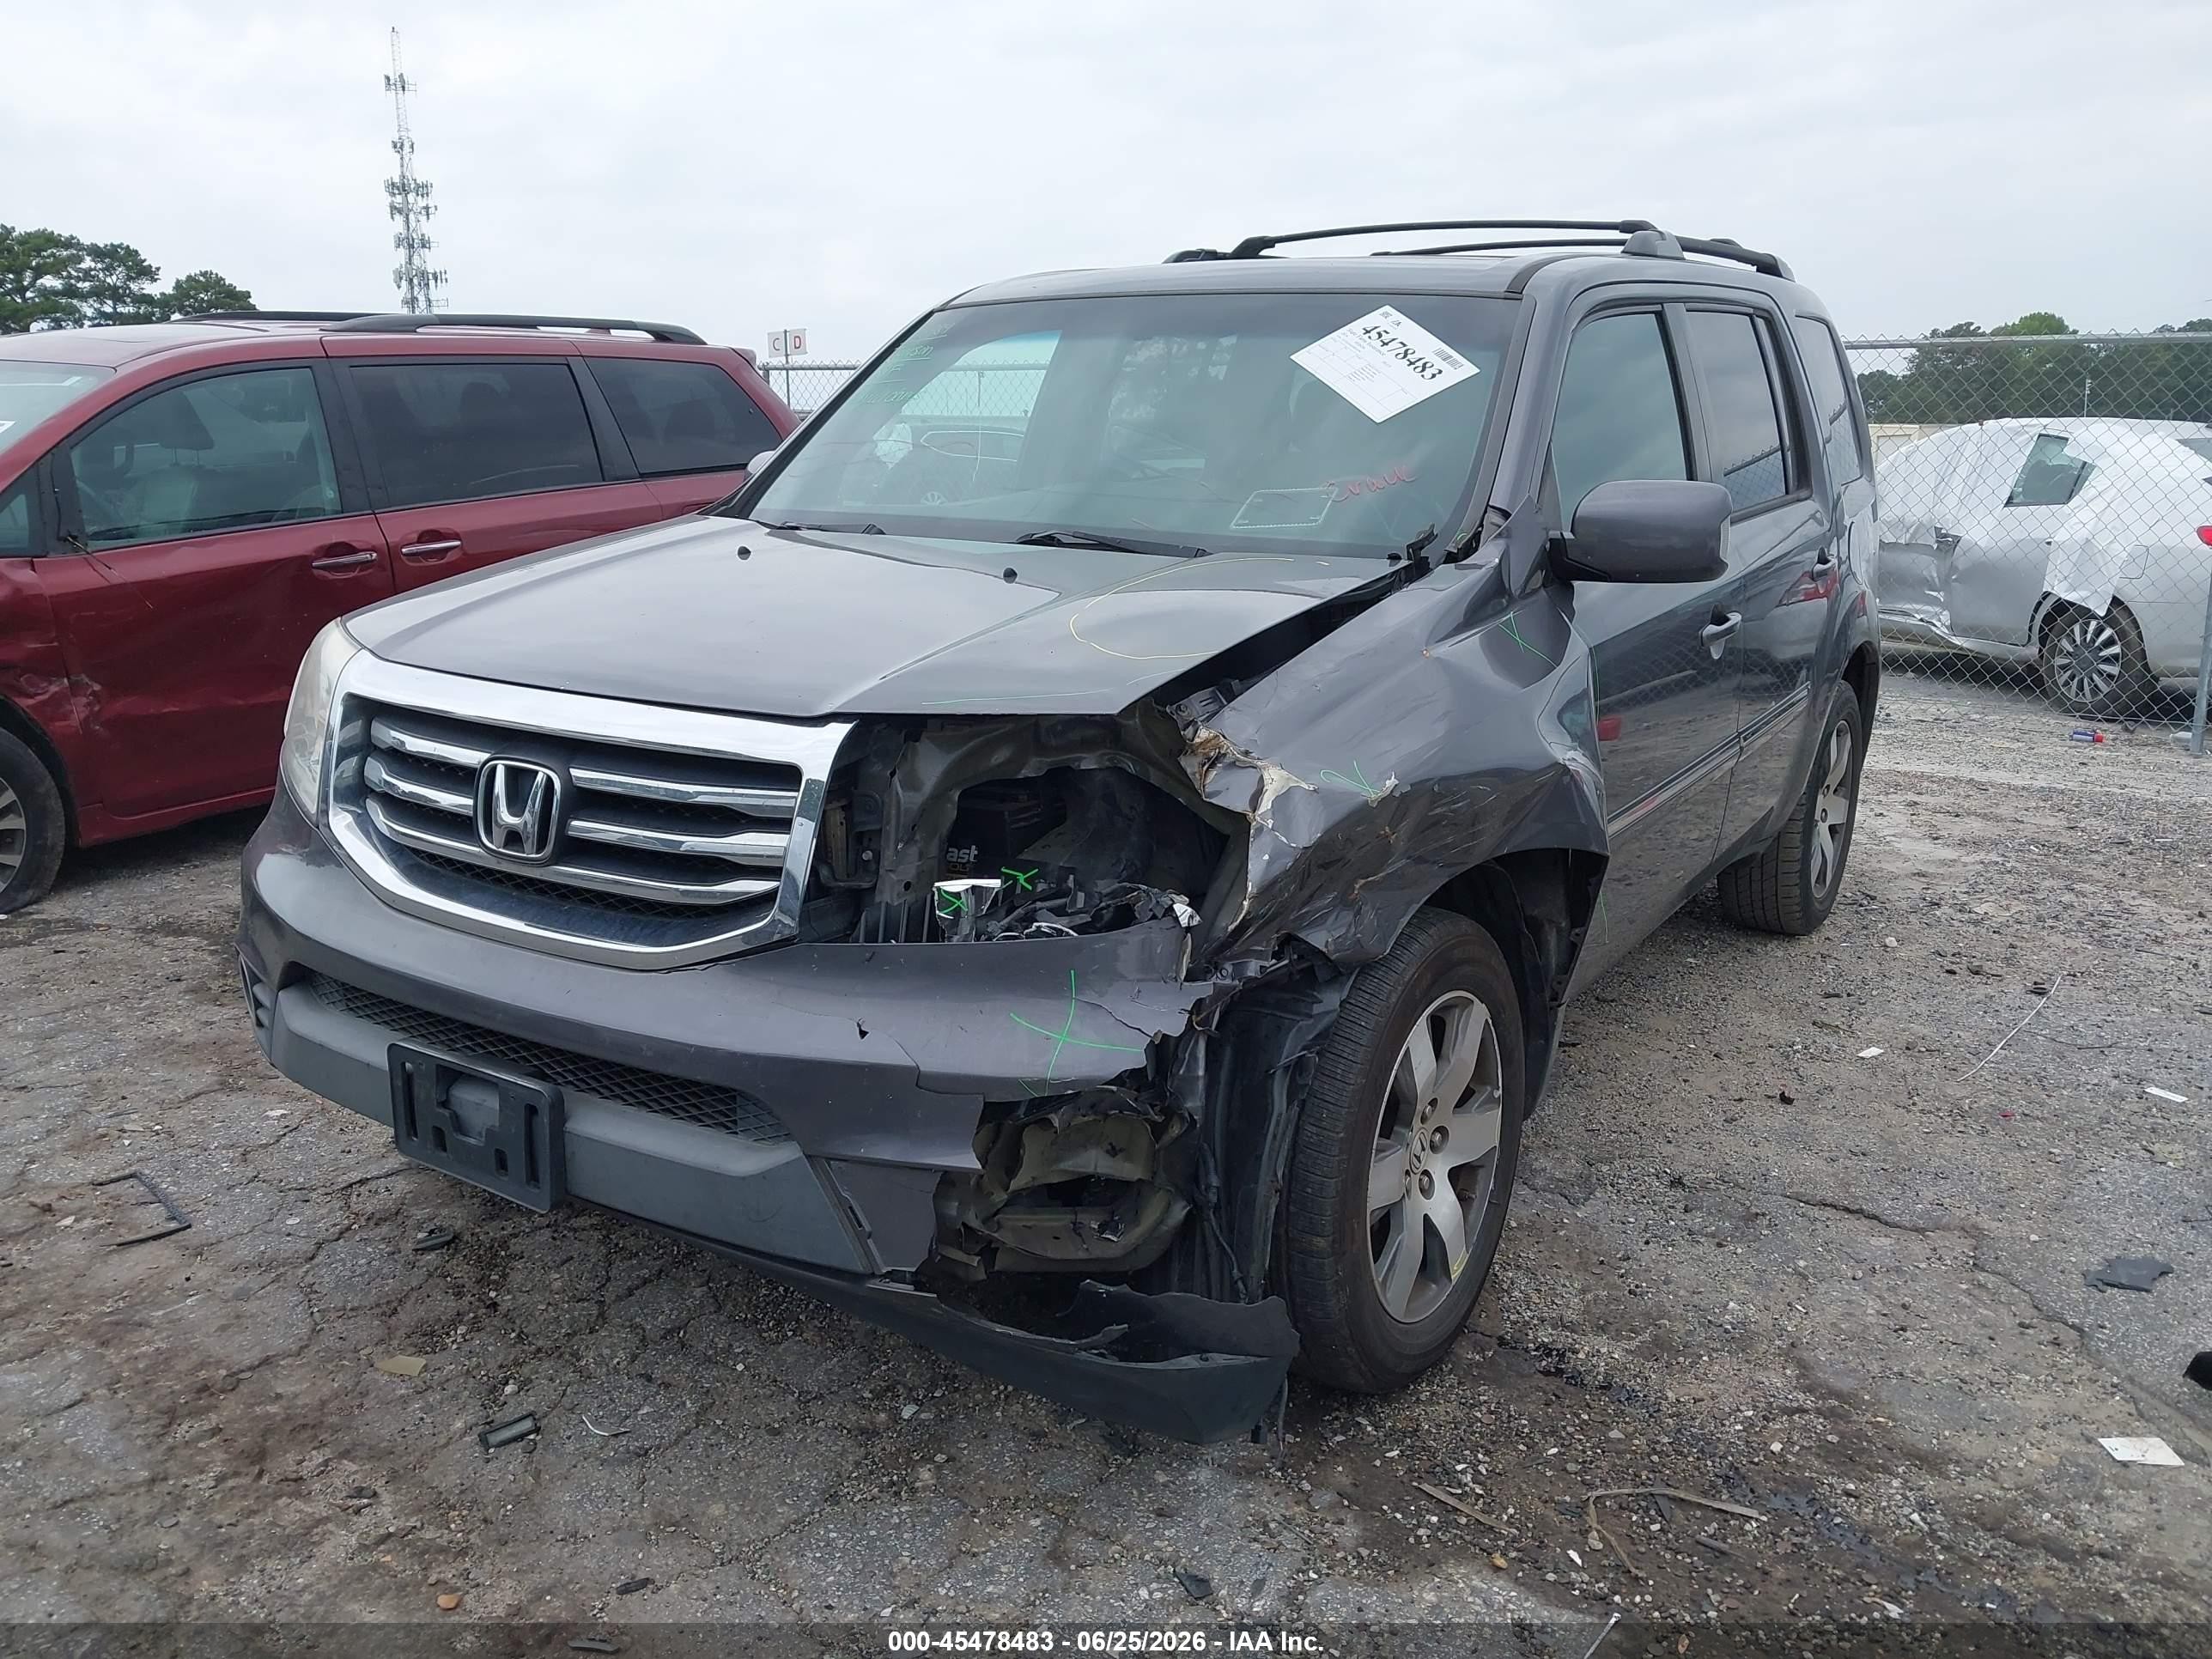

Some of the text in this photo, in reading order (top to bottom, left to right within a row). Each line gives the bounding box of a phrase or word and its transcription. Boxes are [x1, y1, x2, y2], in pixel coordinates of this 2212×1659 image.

[773, 335, 802, 351] C D
[1361, 325, 1443, 380] 45478483
[946, 845, 978, 863] ast
